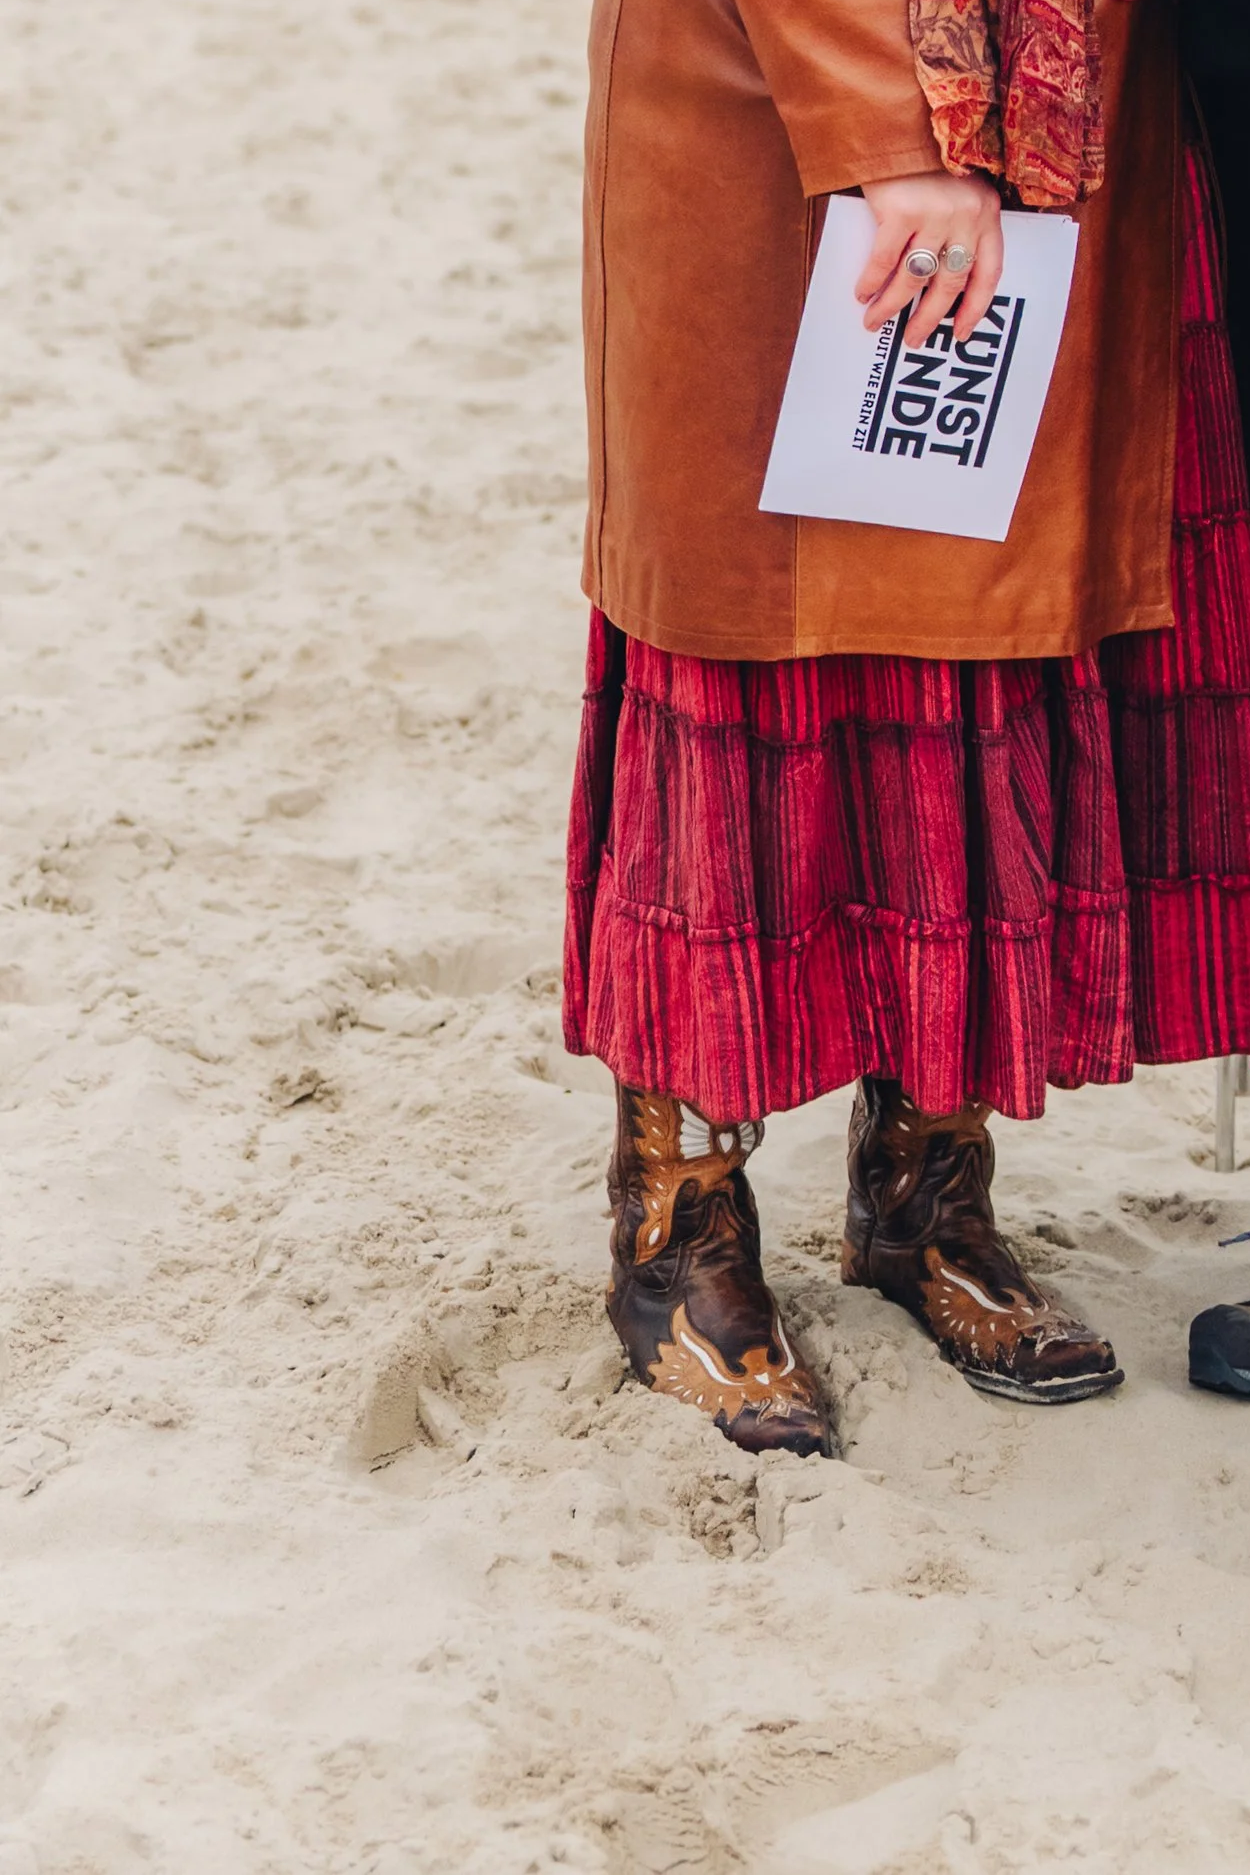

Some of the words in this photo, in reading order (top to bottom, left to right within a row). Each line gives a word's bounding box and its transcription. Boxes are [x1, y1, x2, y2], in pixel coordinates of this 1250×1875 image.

[867, 362, 885, 389] WIE
[929, 295, 1011, 466] KUNST
[859, 390, 876, 425] ERIN
[852, 427, 868, 451] ZIT
